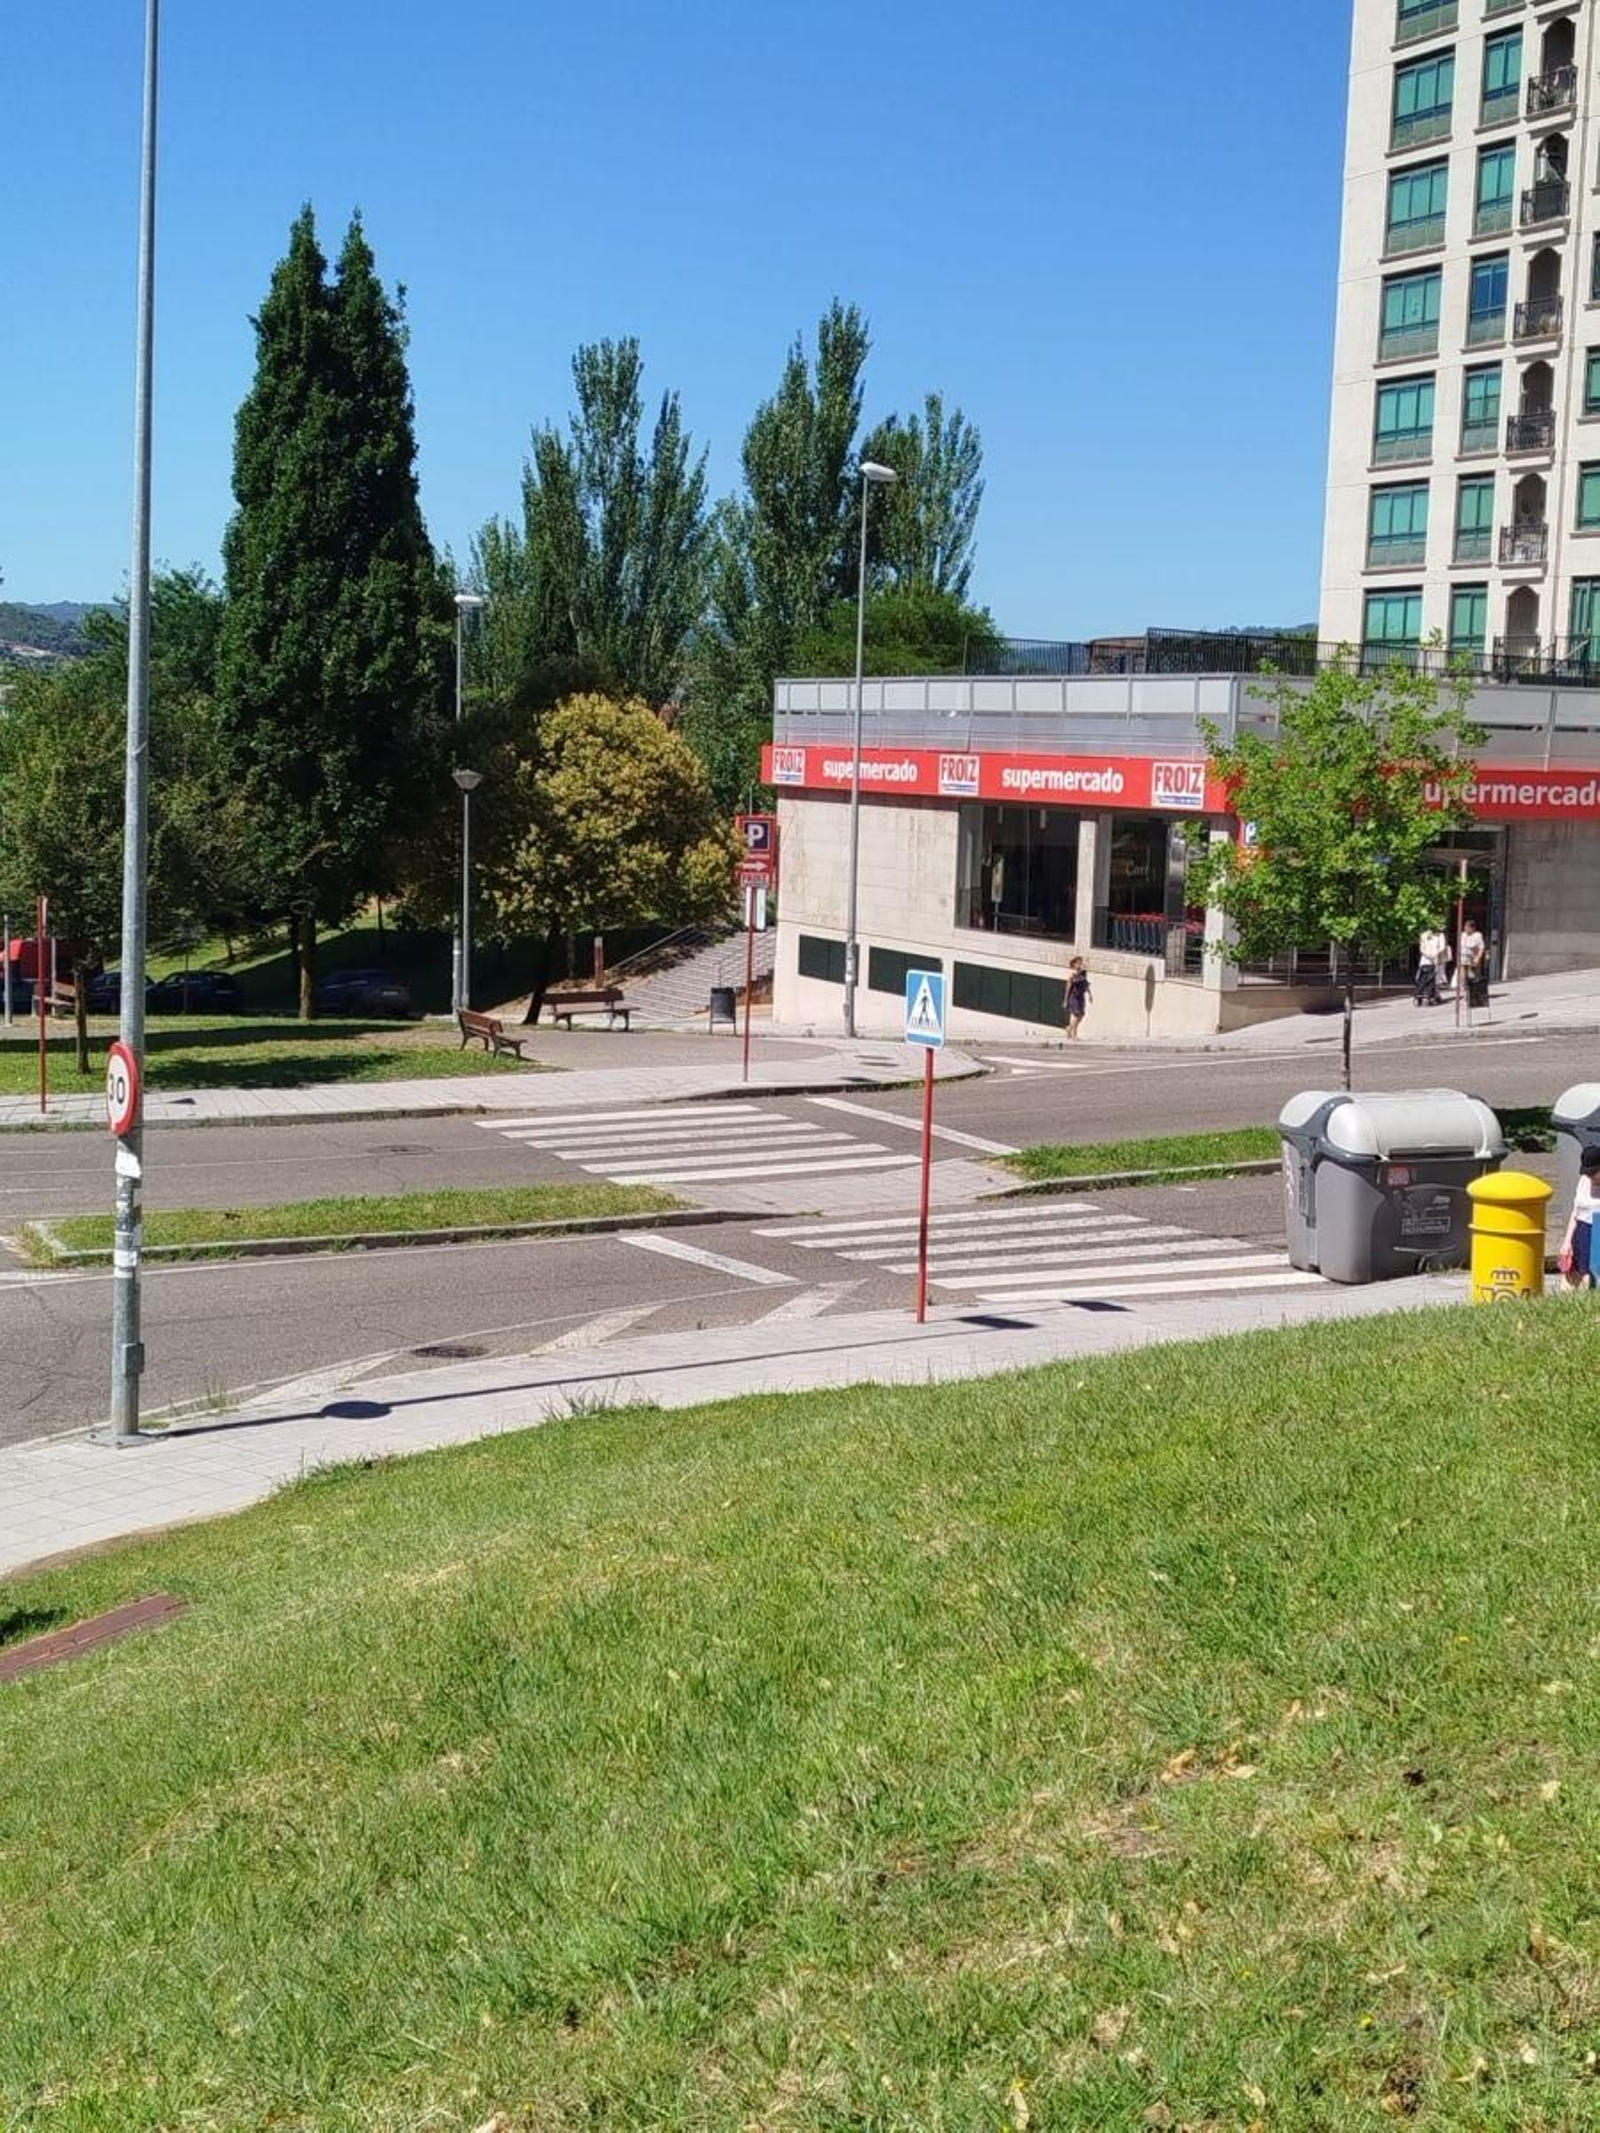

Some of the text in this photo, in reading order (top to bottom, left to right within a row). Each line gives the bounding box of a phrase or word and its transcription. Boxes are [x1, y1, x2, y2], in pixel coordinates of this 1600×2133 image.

[774, 751, 802, 773] FROIZ
[823, 759, 918, 783] supemercado
[941, 758, 976, 783] FROIZ
[1002, 767, 1123, 794] supermercado
[1154, 765, 1202, 794] FROIZ
[747, 824, 764, 847] P
[109, 1073, 126, 1104] 30
